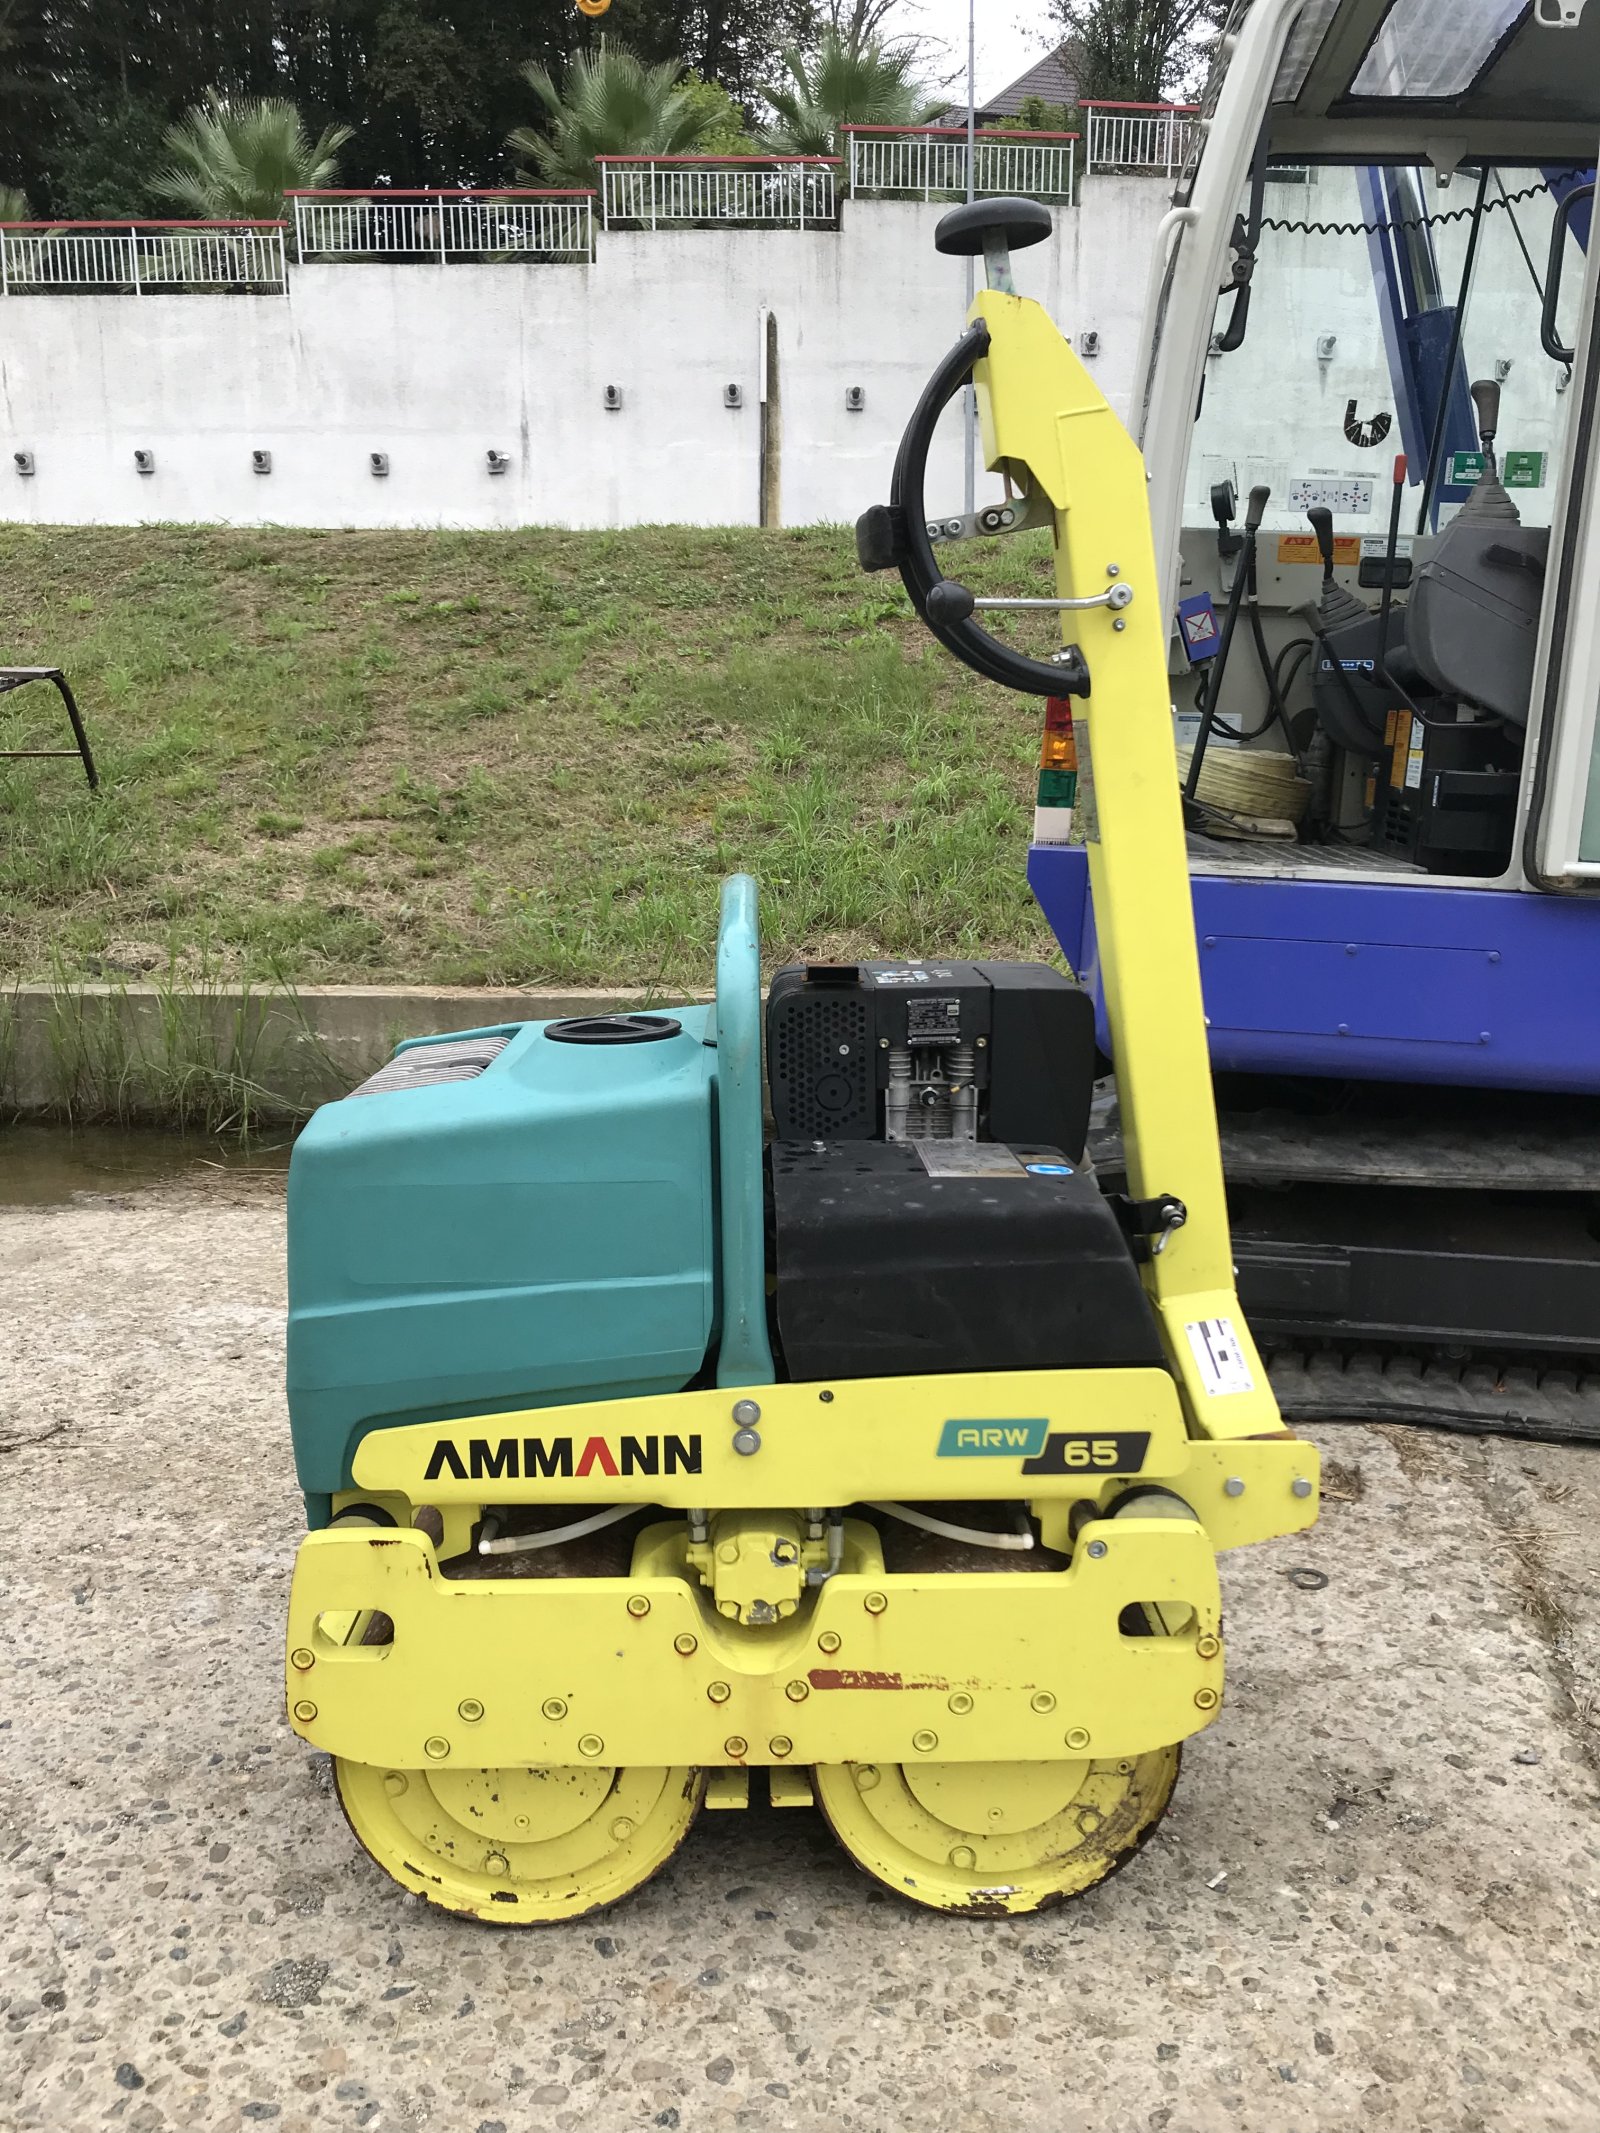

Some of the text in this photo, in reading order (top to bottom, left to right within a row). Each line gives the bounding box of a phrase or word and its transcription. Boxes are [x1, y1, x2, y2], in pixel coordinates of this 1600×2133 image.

[424, 1434, 702, 1480] AMMANN
[957, 1428, 1118, 1467] ARW 65
